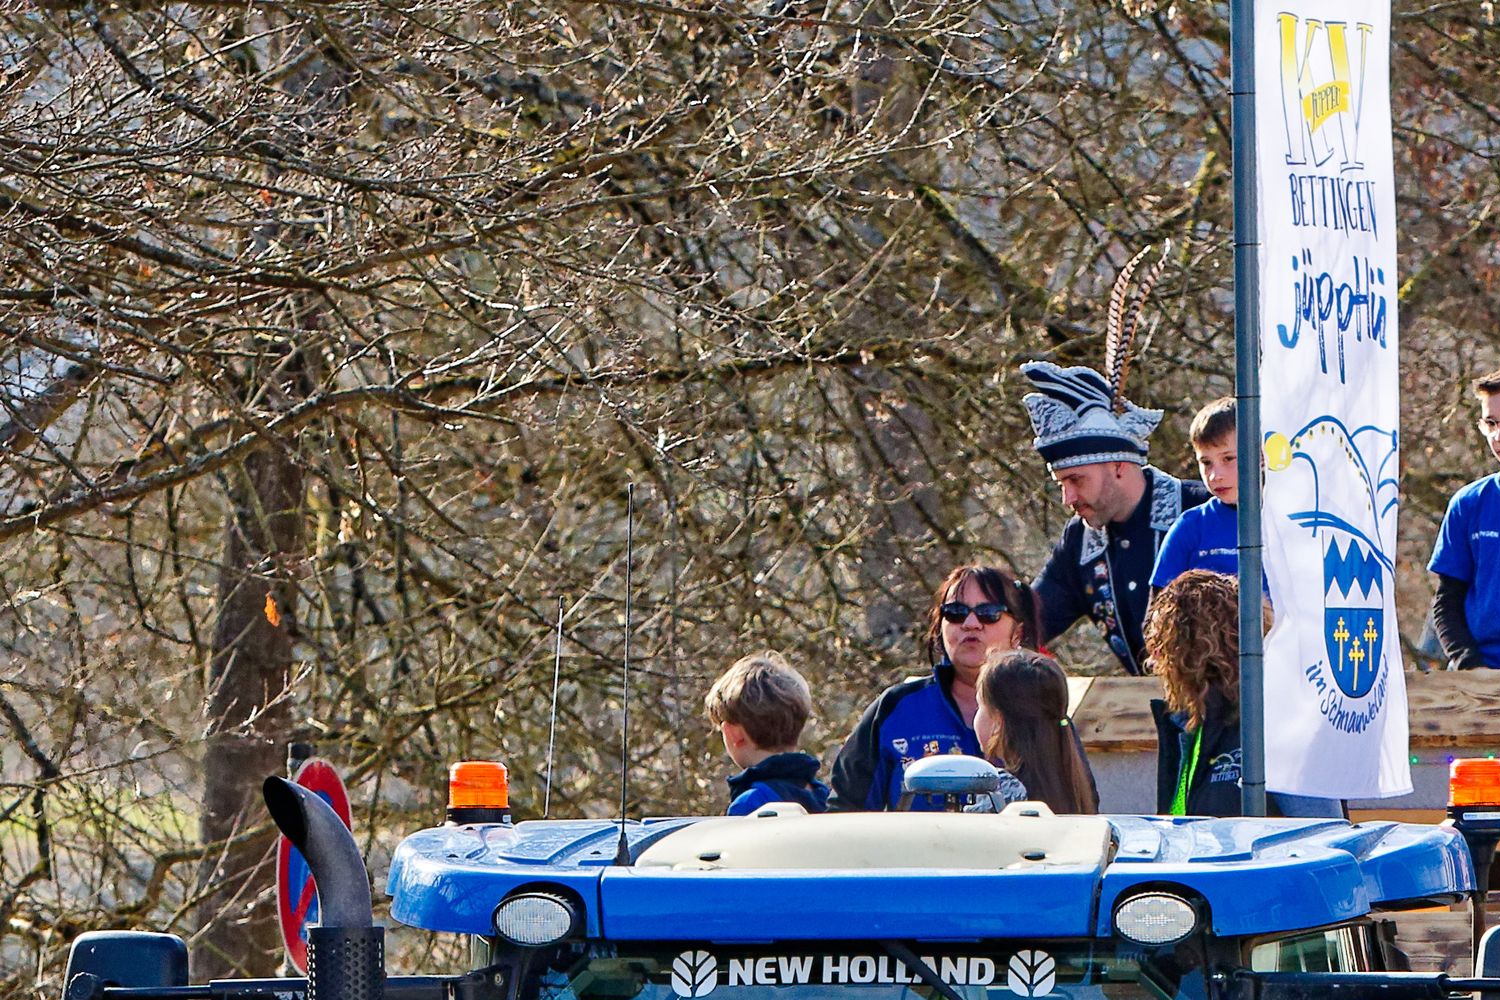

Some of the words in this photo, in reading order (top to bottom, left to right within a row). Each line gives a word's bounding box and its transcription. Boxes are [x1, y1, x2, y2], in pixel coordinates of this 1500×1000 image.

[1277, 12, 1373, 173] KV
[1289, 173, 1378, 241] BETTINGEN
[1306, 660, 1327, 695] im
[729, 957, 812, 986] NEW
